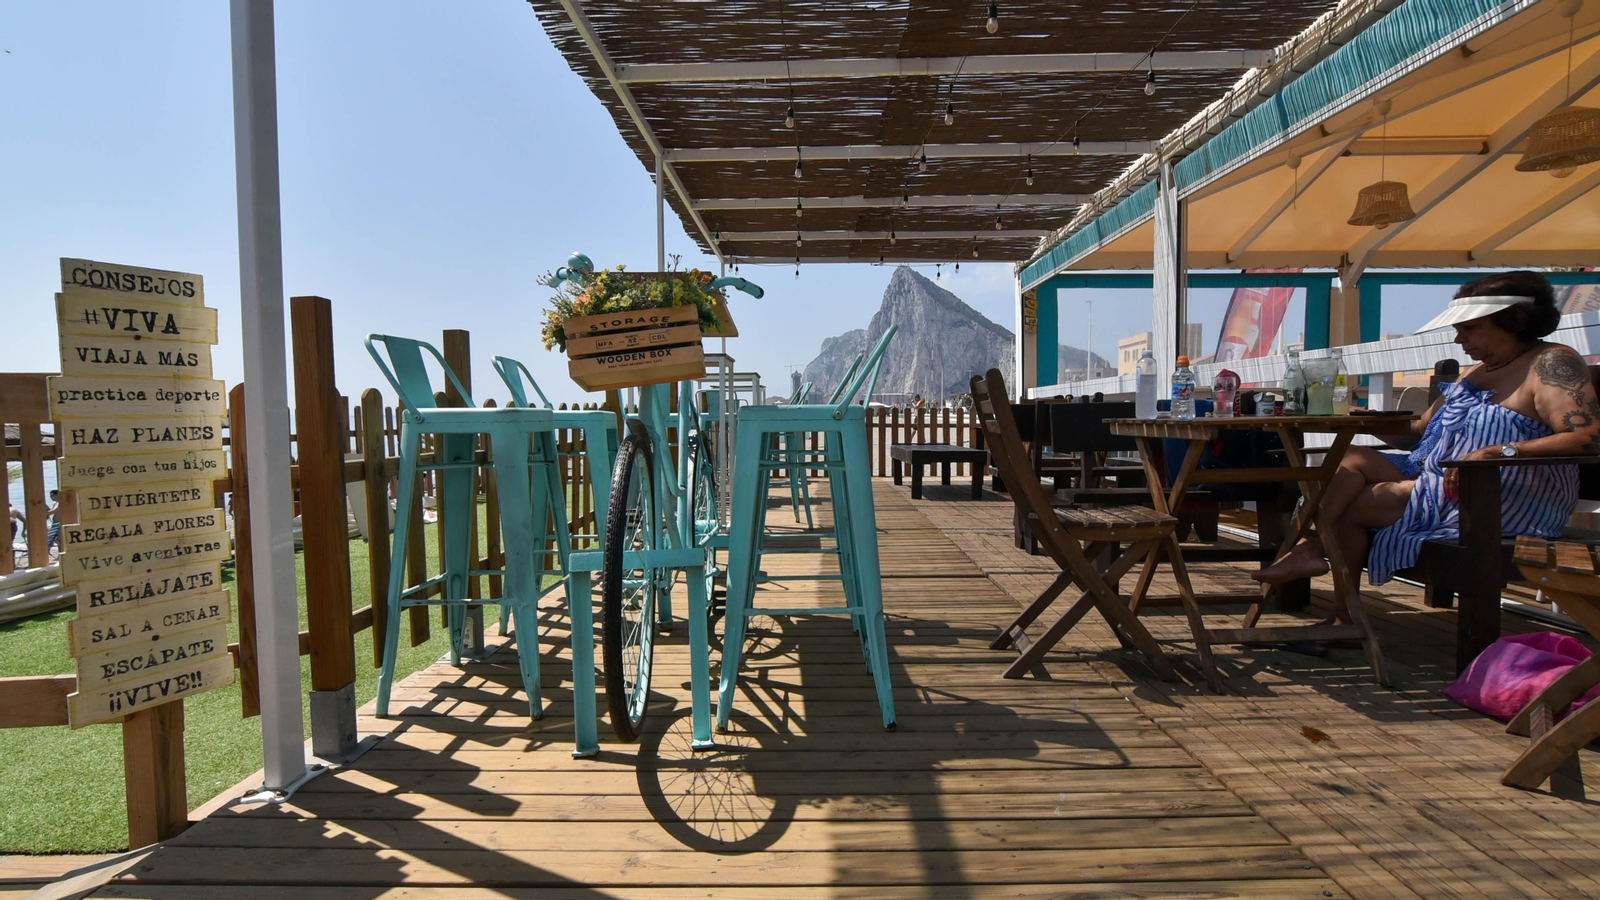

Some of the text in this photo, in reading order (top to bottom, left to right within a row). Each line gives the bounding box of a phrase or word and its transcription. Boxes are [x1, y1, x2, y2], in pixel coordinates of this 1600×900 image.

[71, 267, 196, 298] CONSEJOS
[80, 307, 181, 335] #VIVA
[589, 316, 671, 332] STORAGE
[75, 347, 199, 367] VIAJA MÁS
[596, 349, 672, 365] WOODEN BOX
[57, 388, 220, 404] practica deporte
[71, 426, 215, 445] HAZ PLANES
[68, 459, 217, 478] Juega con tus hijos
[88, 488, 201, 511] DIVIÉRTETE
[68, 515, 215, 544] REGALA FLORES
[79, 541, 221, 570] Vive aventuras
[89, 571, 214, 608] RELÁJATE
[92, 605, 221, 643] SAL A CENAR
[100, 639, 214, 680] ESCÁPATE
